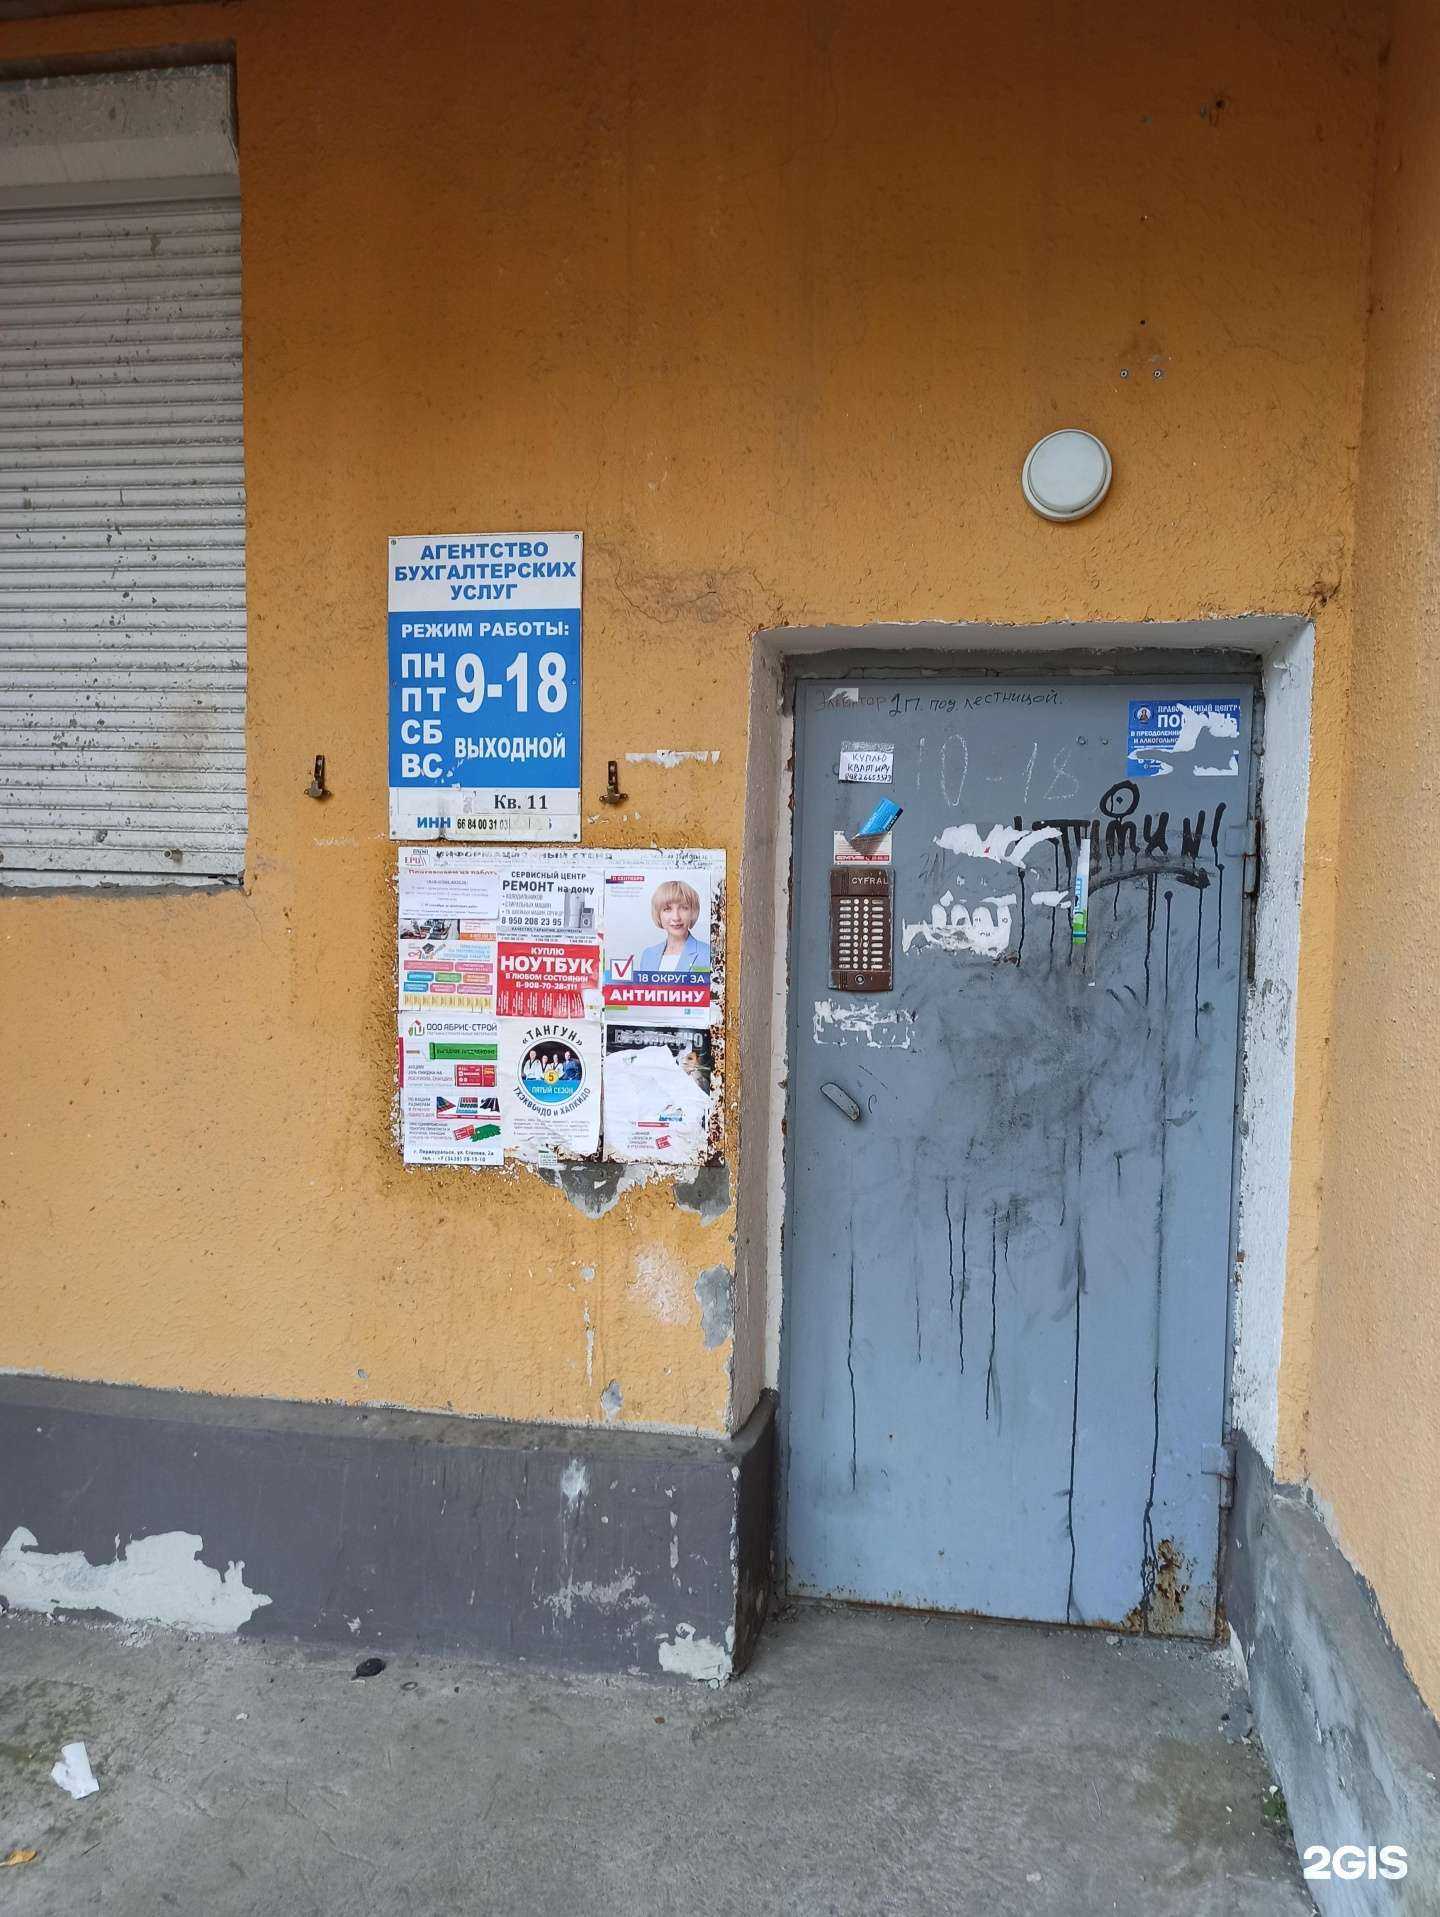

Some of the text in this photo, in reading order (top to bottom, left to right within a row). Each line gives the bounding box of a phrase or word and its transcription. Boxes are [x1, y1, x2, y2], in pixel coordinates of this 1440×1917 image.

[420, 541, 549, 560] АГЕНТСТВО
[394, 561, 577, 582] БУХГАЛТЕРСКИХ
[450, 583, 518, 600] УСЛУГ
[401, 621, 569, 638] РЕЖИМ РАБОТЫ:
[401, 652, 446, 678] ПН
[455, 652, 568, 714] 9-18
[401, 687, 447, 712] ПТ
[401, 719, 443, 745] СБ
[455, 732, 566, 762] ВЫХОДНОЙ
[401, 753, 443, 779] ВС
[494, 794, 548, 810] Кв. 11
[416, 816, 452, 830] ИНН
[457, 818, 466, 830] 66
[467, 818, 477, 830] 84
[478, 818, 487, 830] 00
[511, 870, 559, 879] СЕРВИСНЫЙ
[851, 877, 889, 885] CYFRAL
[502, 880, 554, 892] РЕМОНТ
[571, 886, 595, 895] дому
[501, 917, 562, 927] 8 950 208 23 95
[531, 947, 565, 955] КУПЛЮ
[500, 955, 594, 974] НОУТБУК
[512, 973, 542, 981] ЛЮБОМ
[543, 974, 589, 983] СОСТОЯНИИ
[638, 973, 705, 984] 18 ОКРУГ ЗА
[609, 988, 706, 1003] АНТИПИНУ
[426, 1023, 443, 1031] ООО
[522, 1025, 583, 1046] «ТАНГУН»
[548, 1072, 555, 1081] 5
[531, 1086, 574, 1094] ПЯТЫЙ СЕЗОН
[560, 1087, 591, 1115] ХАПКИДО
